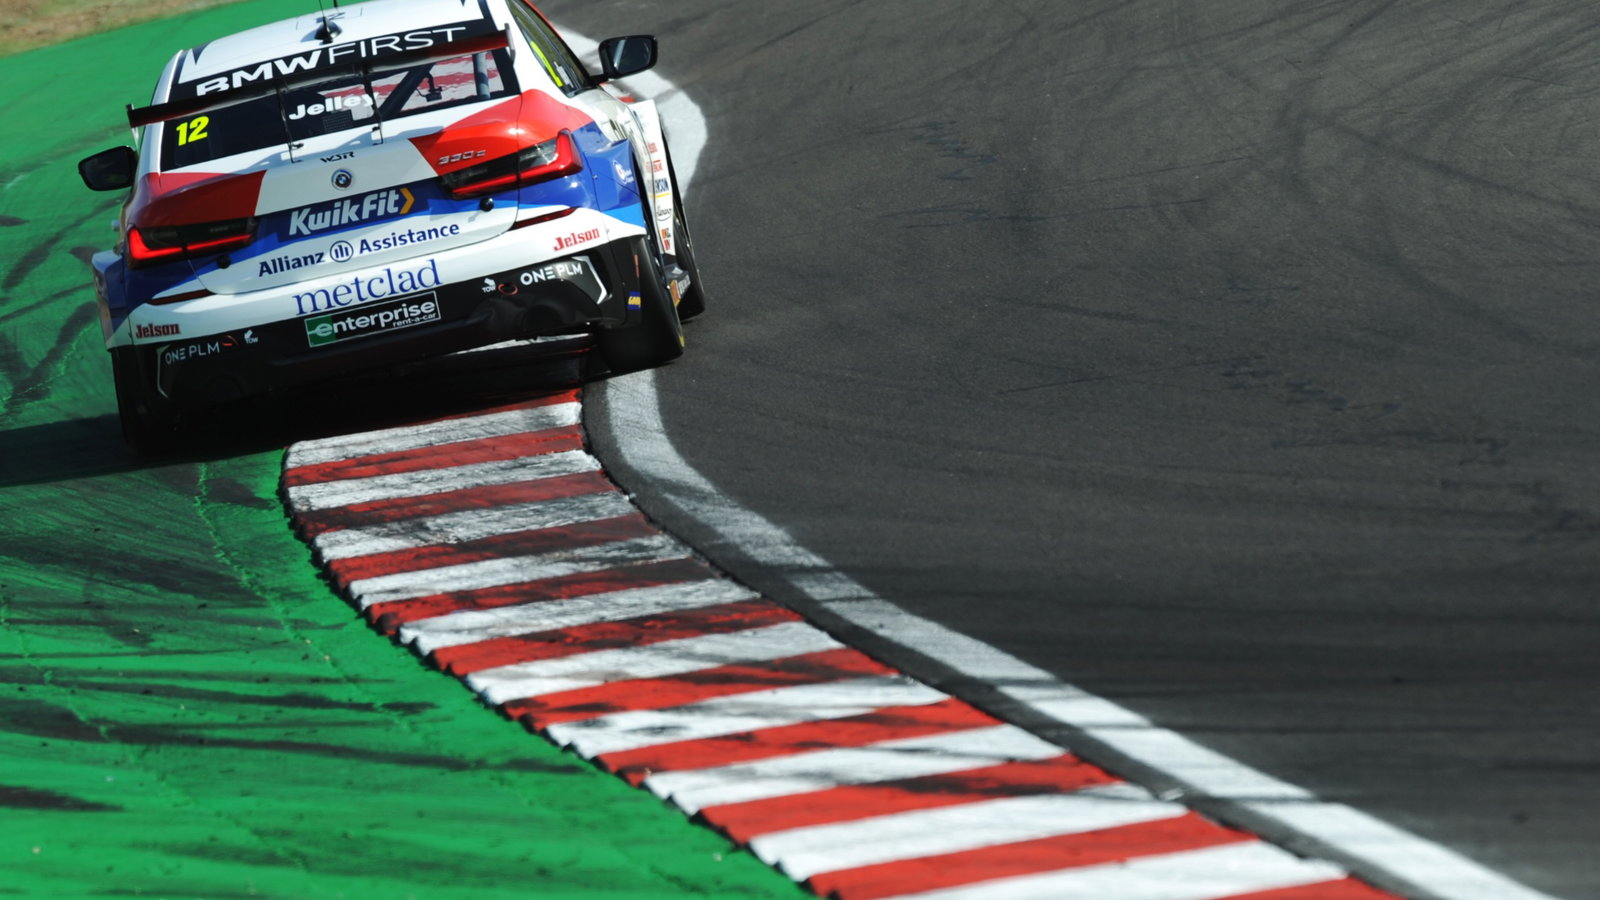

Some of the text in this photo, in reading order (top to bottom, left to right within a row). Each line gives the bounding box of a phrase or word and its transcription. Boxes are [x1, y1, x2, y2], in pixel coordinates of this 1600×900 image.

[176, 116, 210, 146] 12
[258, 224, 460, 277] Allianz Assistance
[553, 228, 600, 251] Jelson
[520, 263, 583, 286] ONE PLM
[292, 259, 443, 316] metclad
[135, 323, 181, 339] Jelson
[310, 301, 436, 337] enterprise
[393, 312, 437, 328] rent-a-car
[165, 341, 220, 365] ONE PLM
